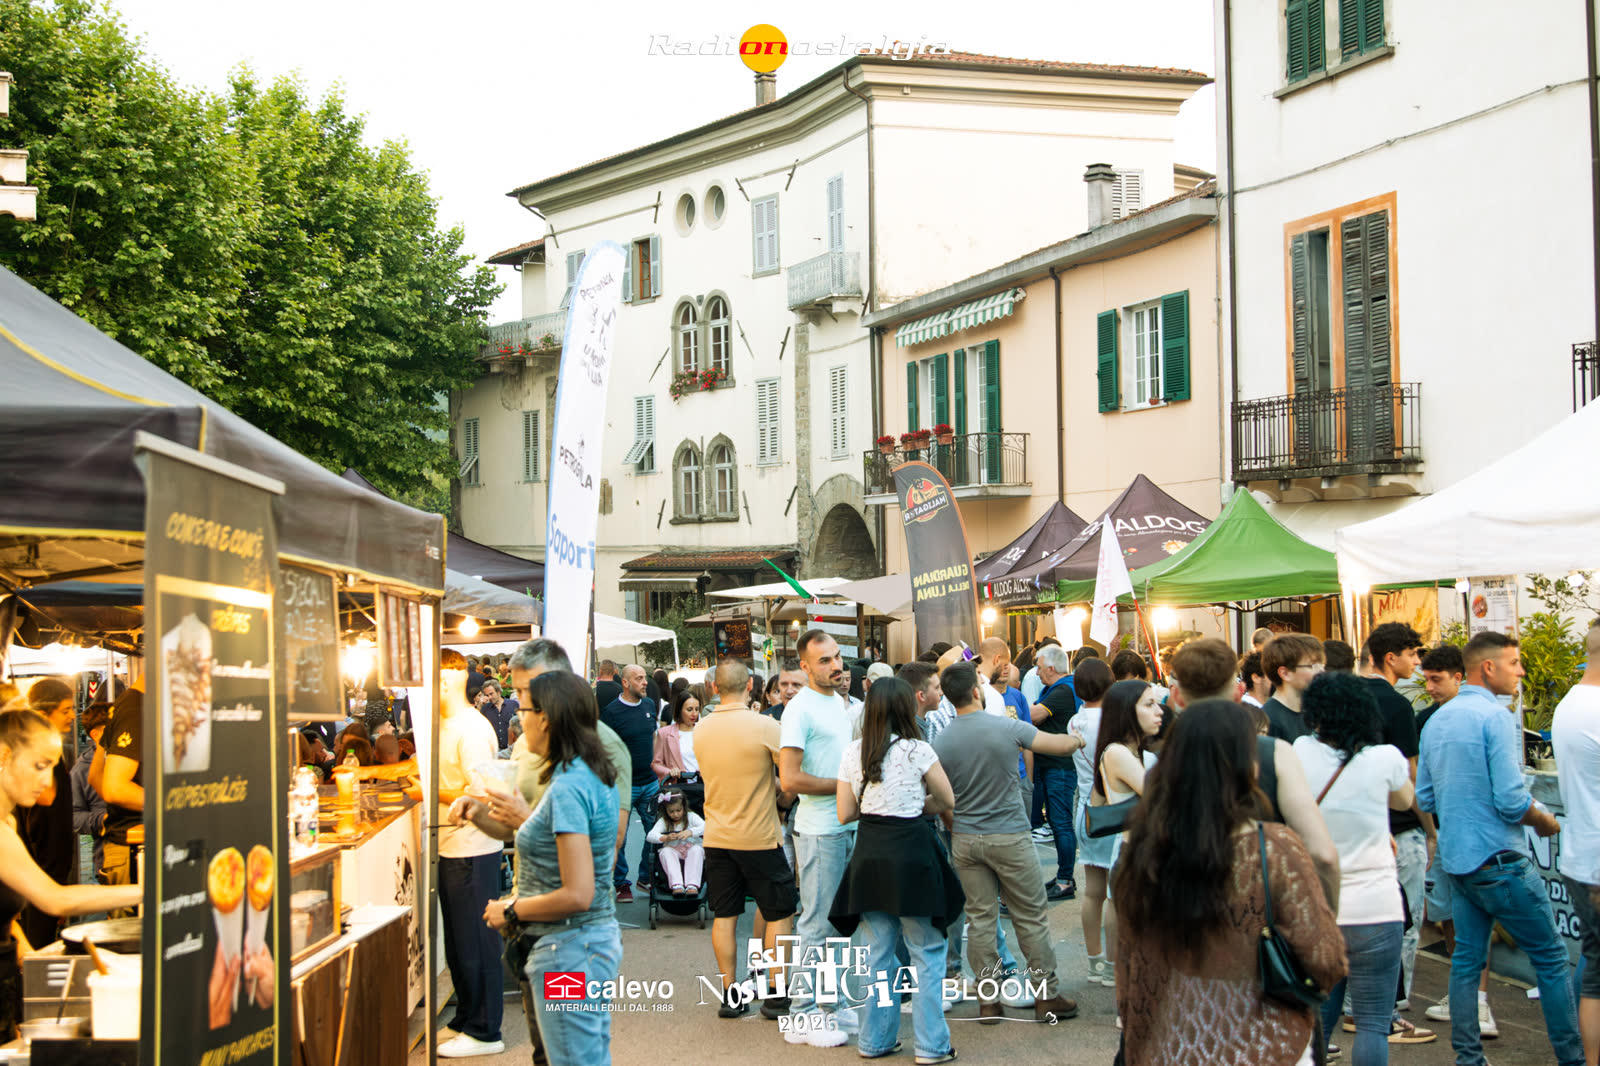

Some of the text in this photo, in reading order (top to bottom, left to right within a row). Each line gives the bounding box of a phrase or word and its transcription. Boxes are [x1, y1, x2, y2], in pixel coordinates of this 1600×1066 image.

[1115, 515, 1206, 533] ALDOG
[549, 513, 596, 570] Sapori
[993, 580, 1013, 597] ALDOG
